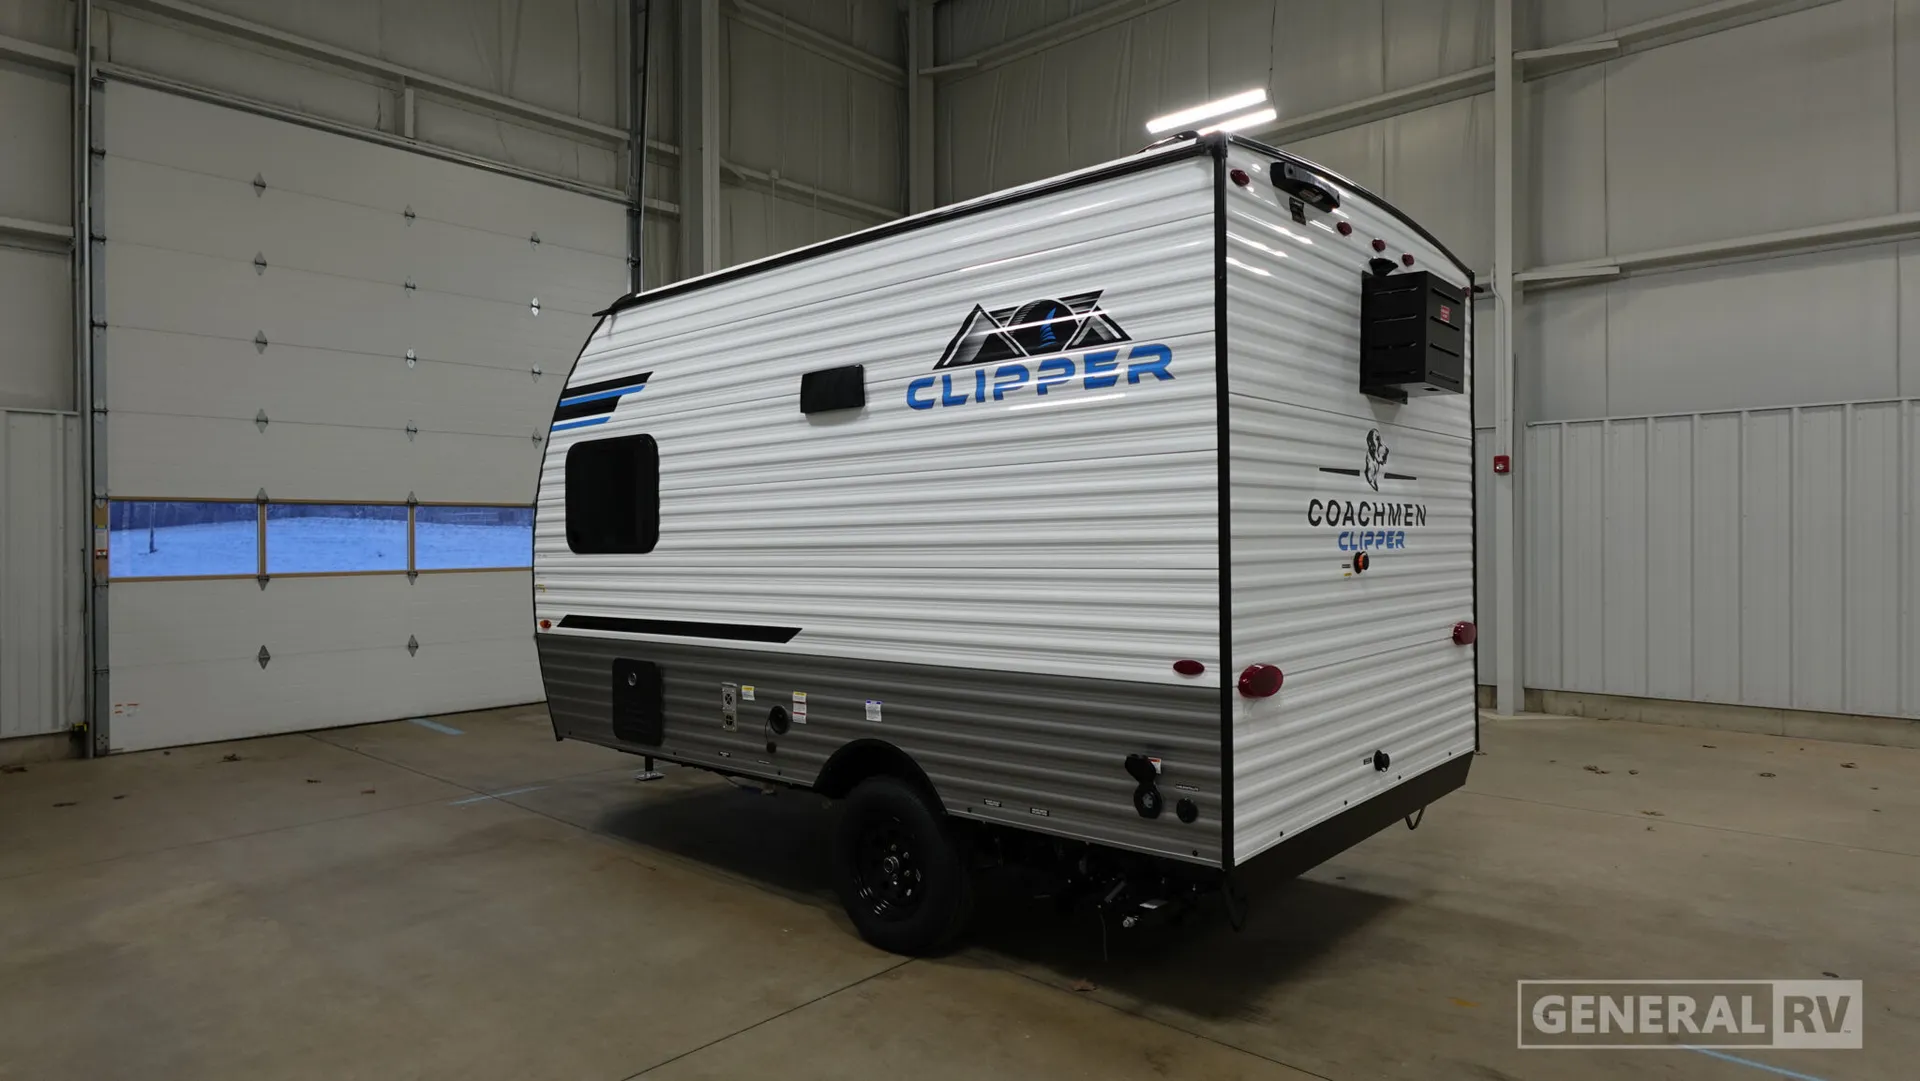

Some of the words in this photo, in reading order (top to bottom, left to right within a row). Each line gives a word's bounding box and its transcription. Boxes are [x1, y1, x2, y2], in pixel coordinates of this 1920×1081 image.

[906, 343, 1175, 410] CLIPPER
[1308, 498, 1427, 527] COACHMEN
[1338, 530, 1405, 551] CLIPPER
